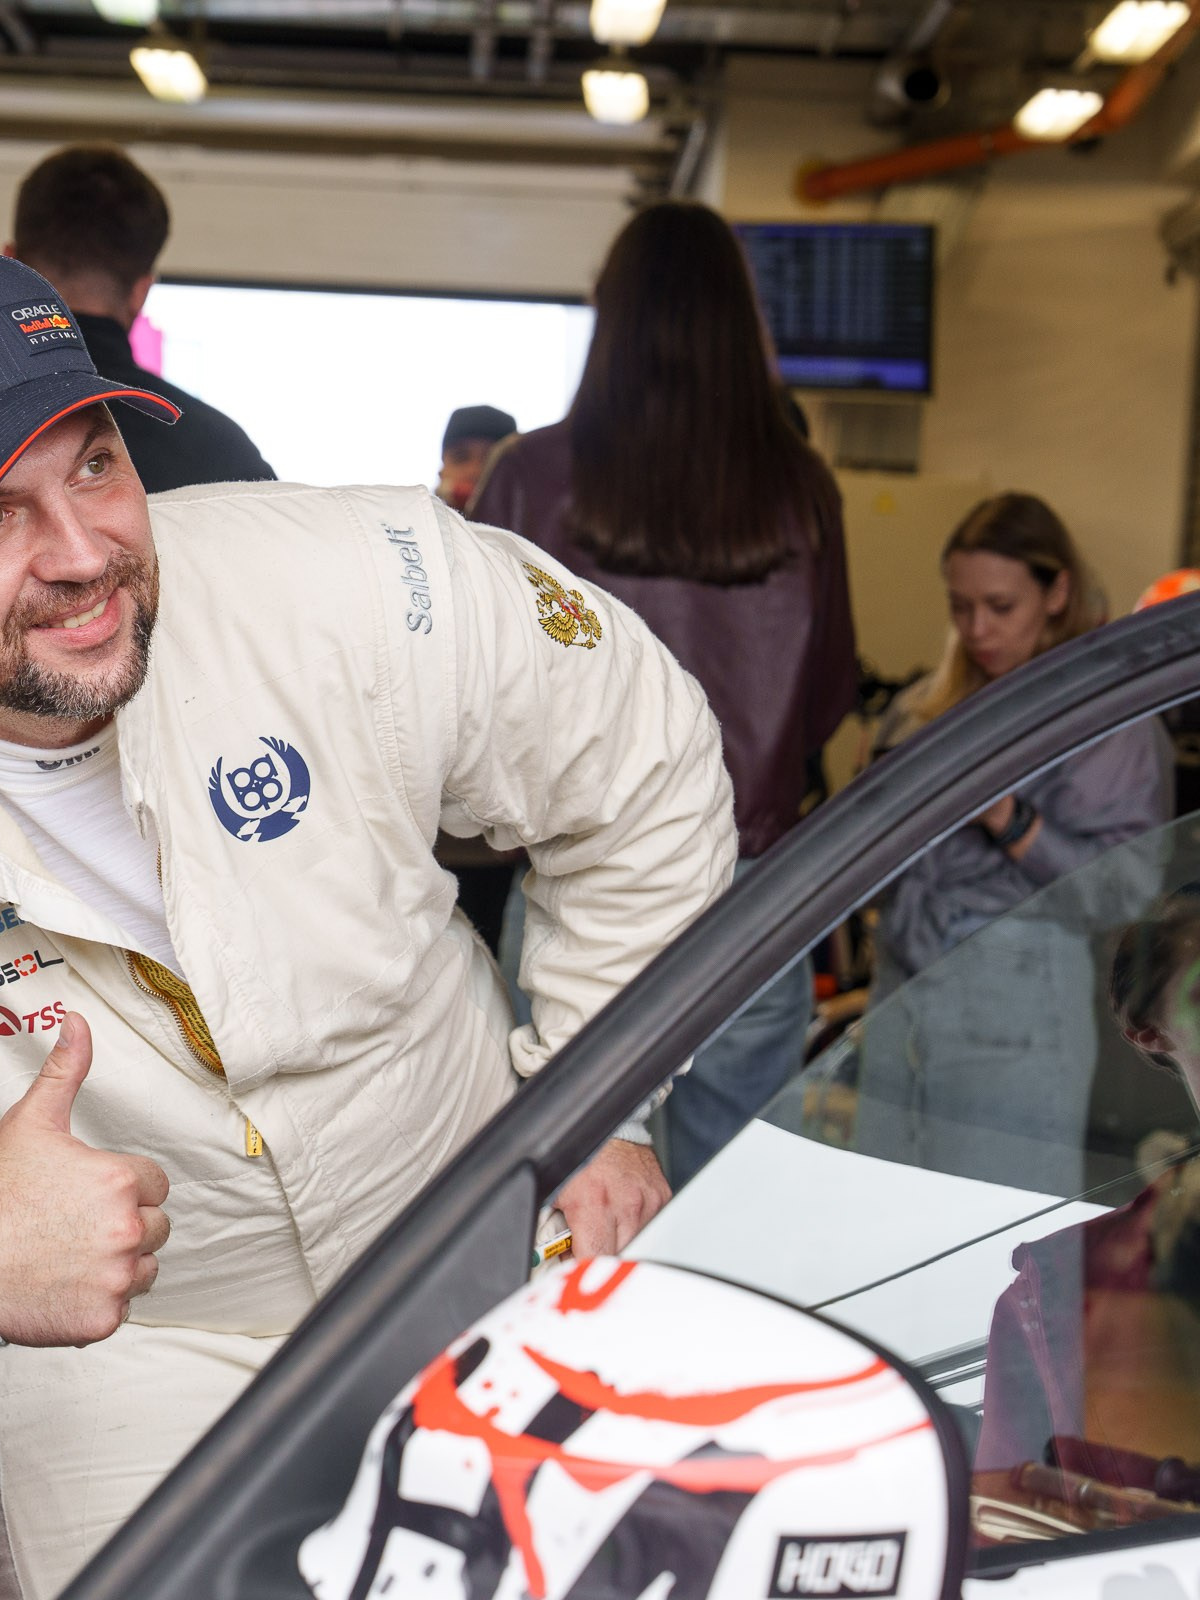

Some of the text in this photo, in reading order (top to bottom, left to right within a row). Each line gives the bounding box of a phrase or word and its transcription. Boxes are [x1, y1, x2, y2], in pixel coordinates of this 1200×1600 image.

[11, 304, 62, 320] ORACLE
[29, 332, 78, 345] RACING
[384, 525, 433, 635] Sabelt
